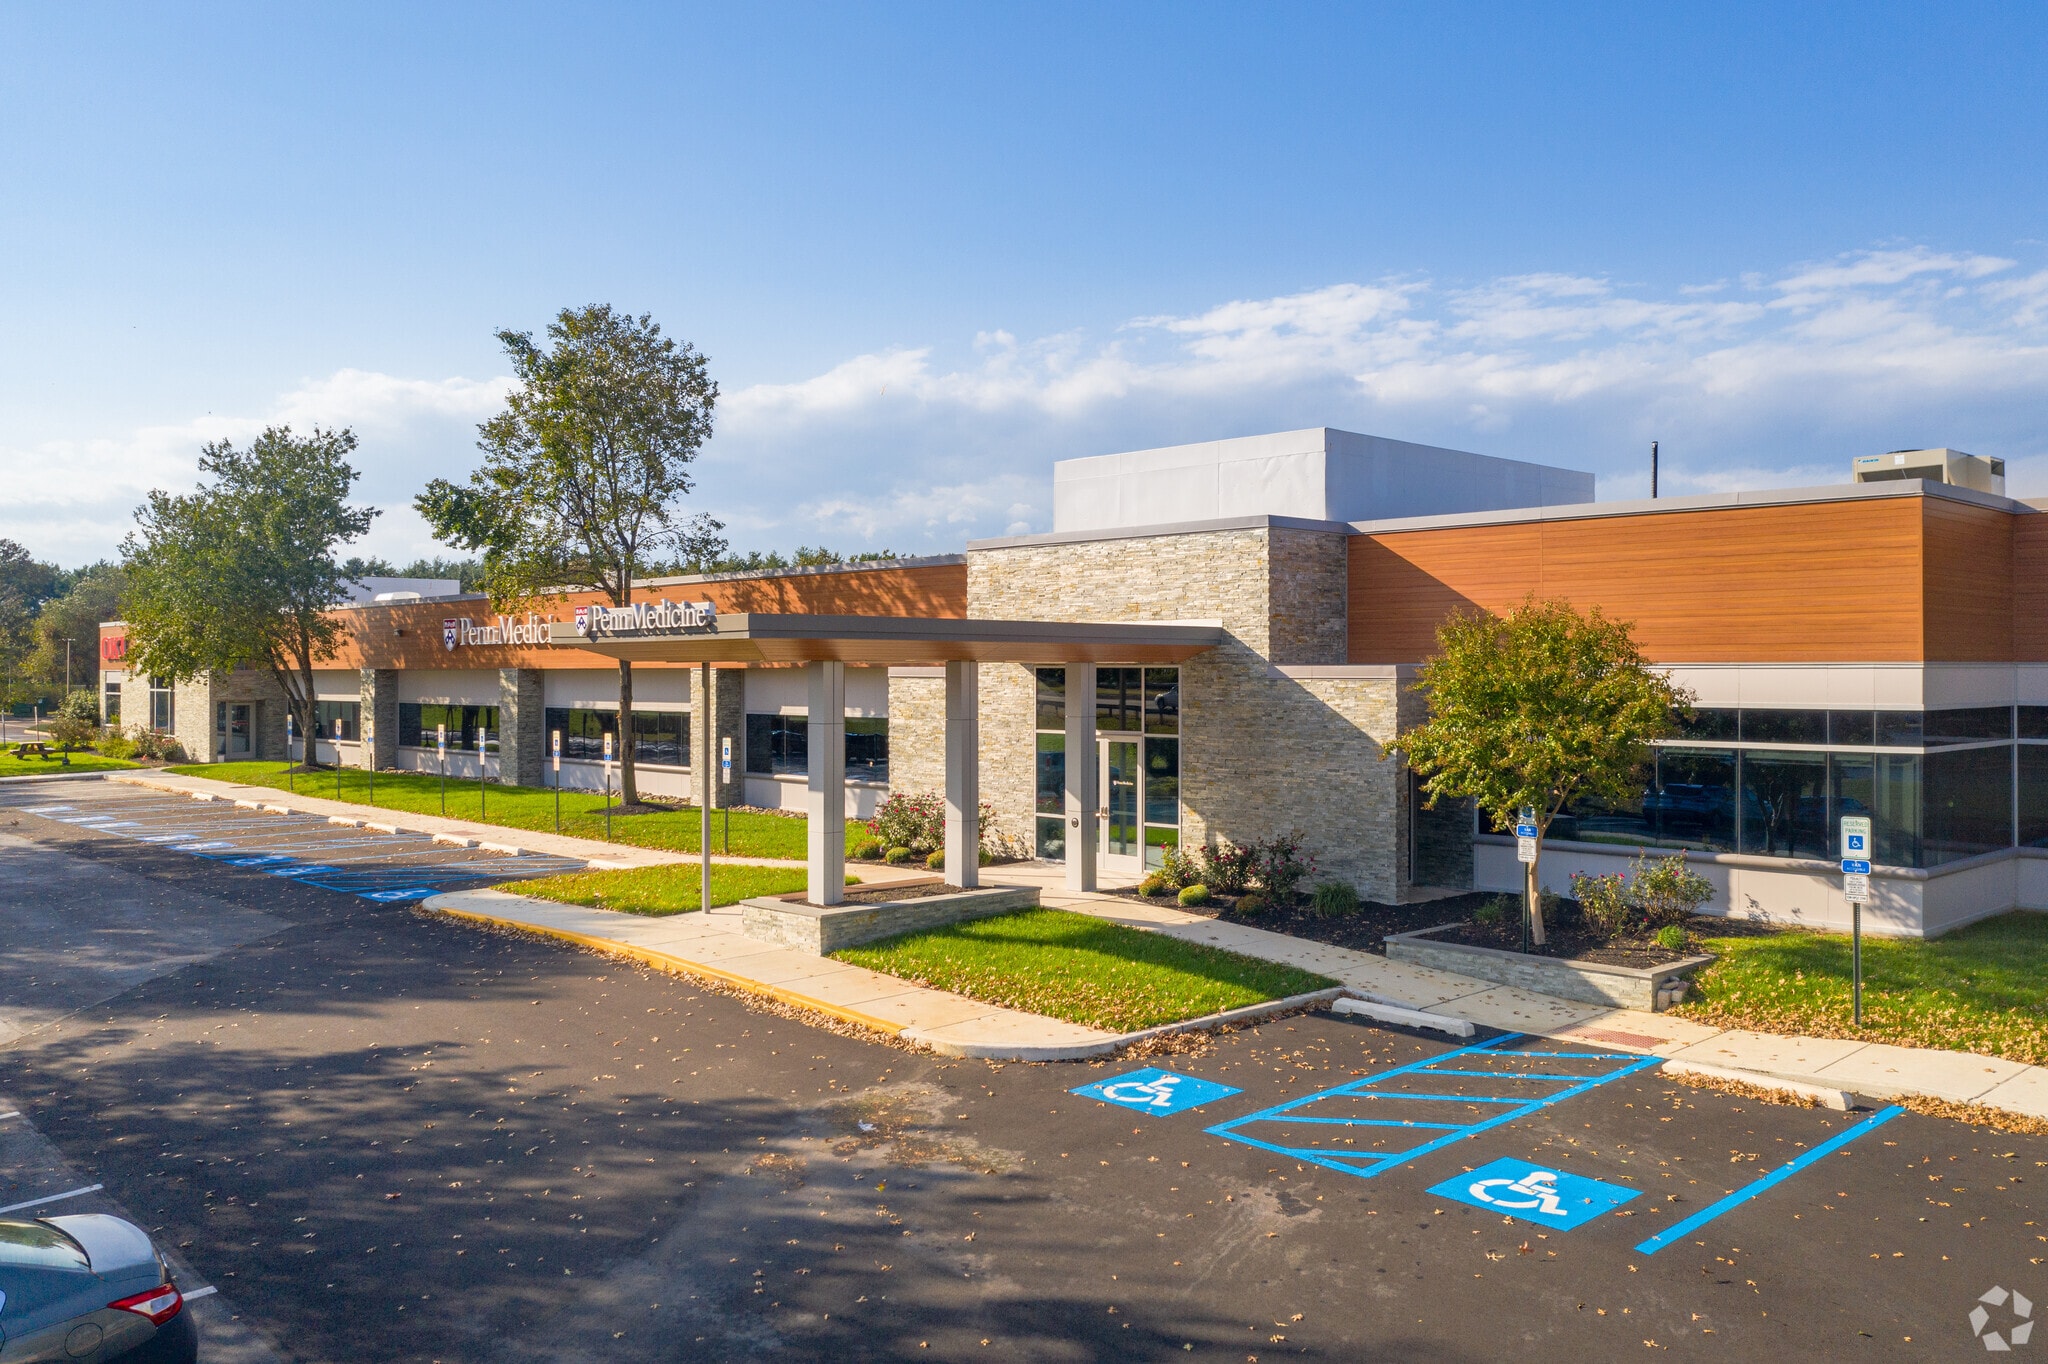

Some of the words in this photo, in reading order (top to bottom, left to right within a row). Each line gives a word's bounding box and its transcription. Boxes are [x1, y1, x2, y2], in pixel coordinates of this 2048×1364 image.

[591, 605, 632, 632] Penn
[631, 598, 707, 630] Medicine
[460, 617, 497, 646] Penn
[1843, 820, 1868, 828] RESERVED
